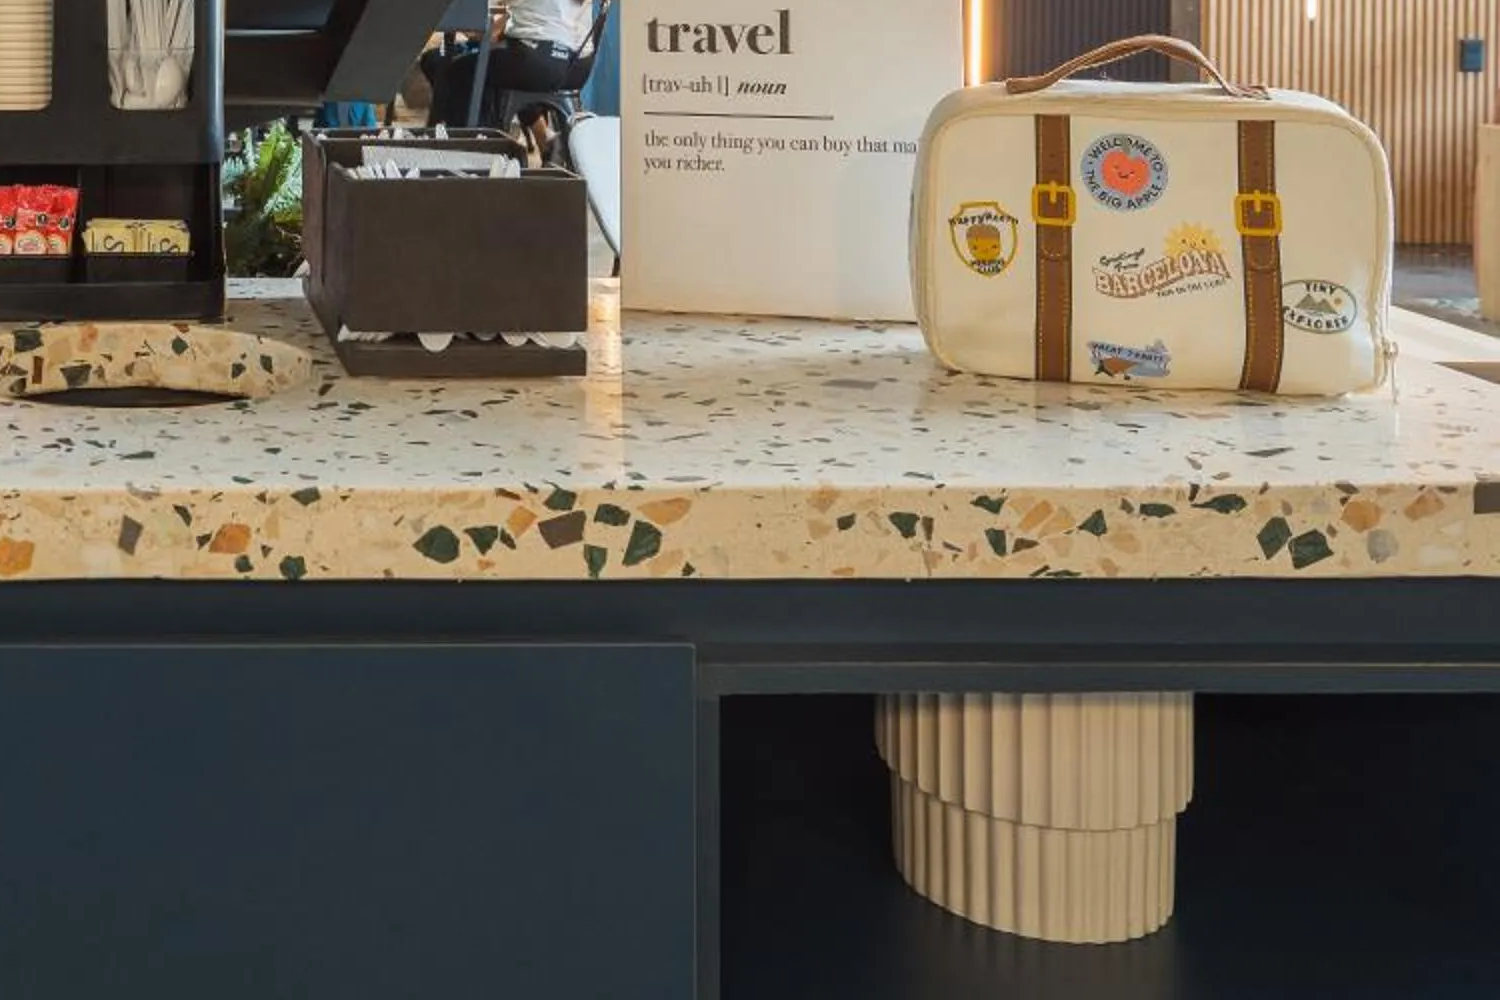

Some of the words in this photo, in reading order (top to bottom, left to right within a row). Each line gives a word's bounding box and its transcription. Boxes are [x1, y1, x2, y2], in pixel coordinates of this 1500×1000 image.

[645, 8, 794, 55] travel
[736, 80, 788, 95] noun
[644, 130, 669, 147] the
[673, 131, 707, 152] only
[711, 132, 754, 153] thing
[756, 137, 786, 155] you
[789, 139, 819, 151] can
[823, 136, 851, 156] buy
[856, 136, 888, 152] that
[892, 141, 917, 153] ma
[643, 157, 671, 175] you
[675, 154, 725, 171] richer.
[1127, 184, 1162, 209] APPLE
[1092, 250, 1231, 299] BARCELONA
[1303, 282, 1337, 295] TINY
